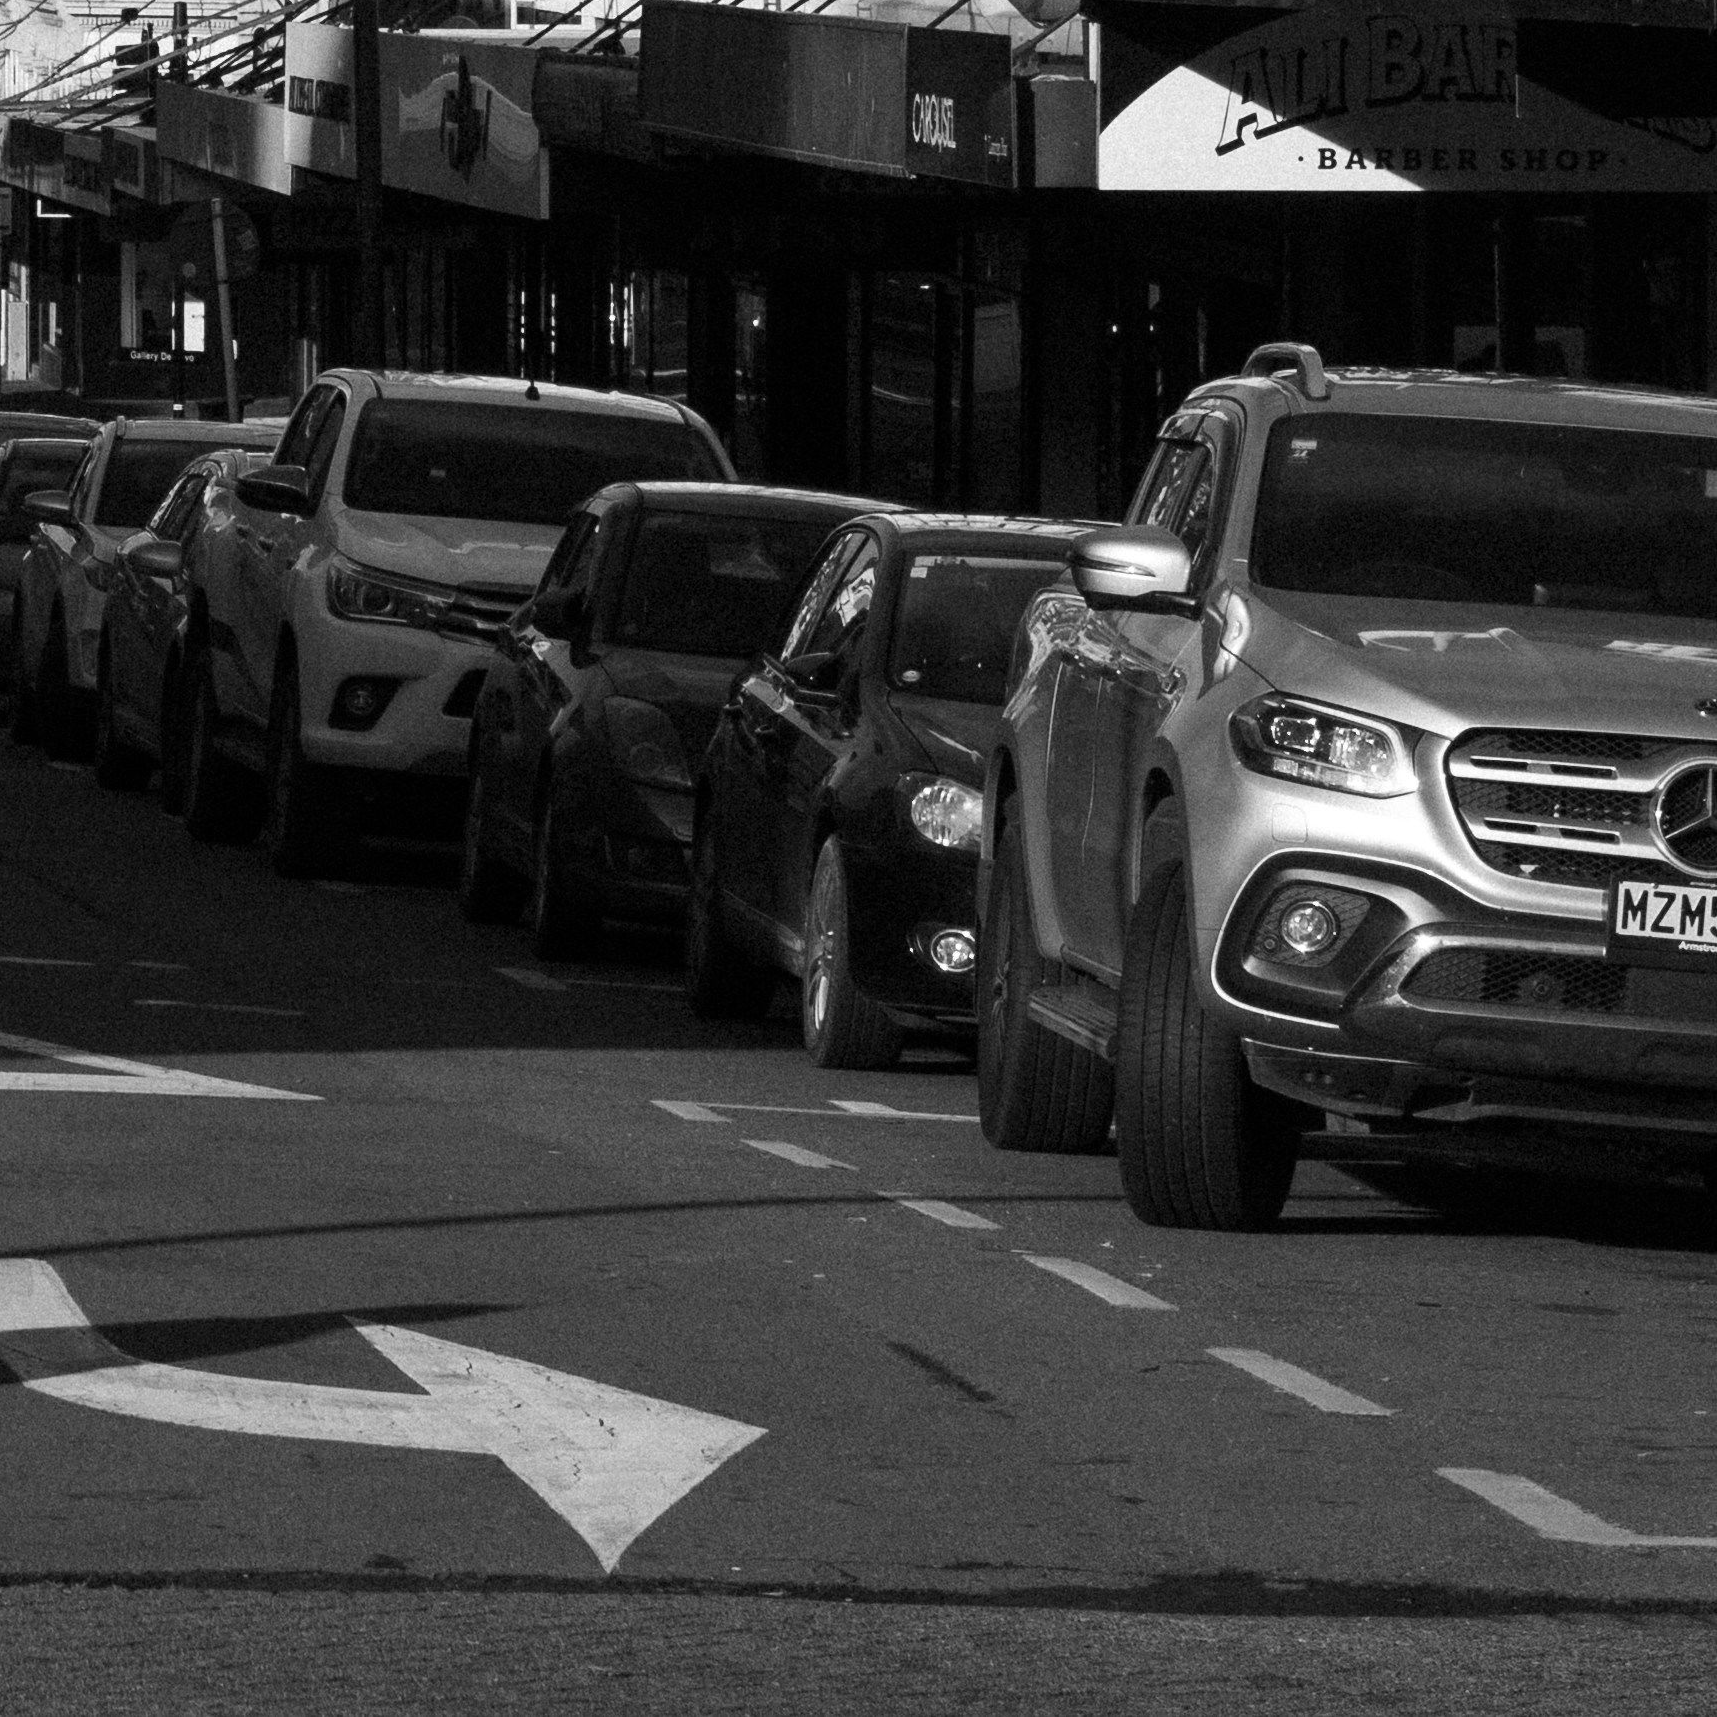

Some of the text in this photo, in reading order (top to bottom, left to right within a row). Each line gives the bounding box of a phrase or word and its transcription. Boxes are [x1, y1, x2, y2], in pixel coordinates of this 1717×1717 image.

[1208, 35, 1348, 156] ALI
[1318, 148, 1609, 171] BARBER SHOP
